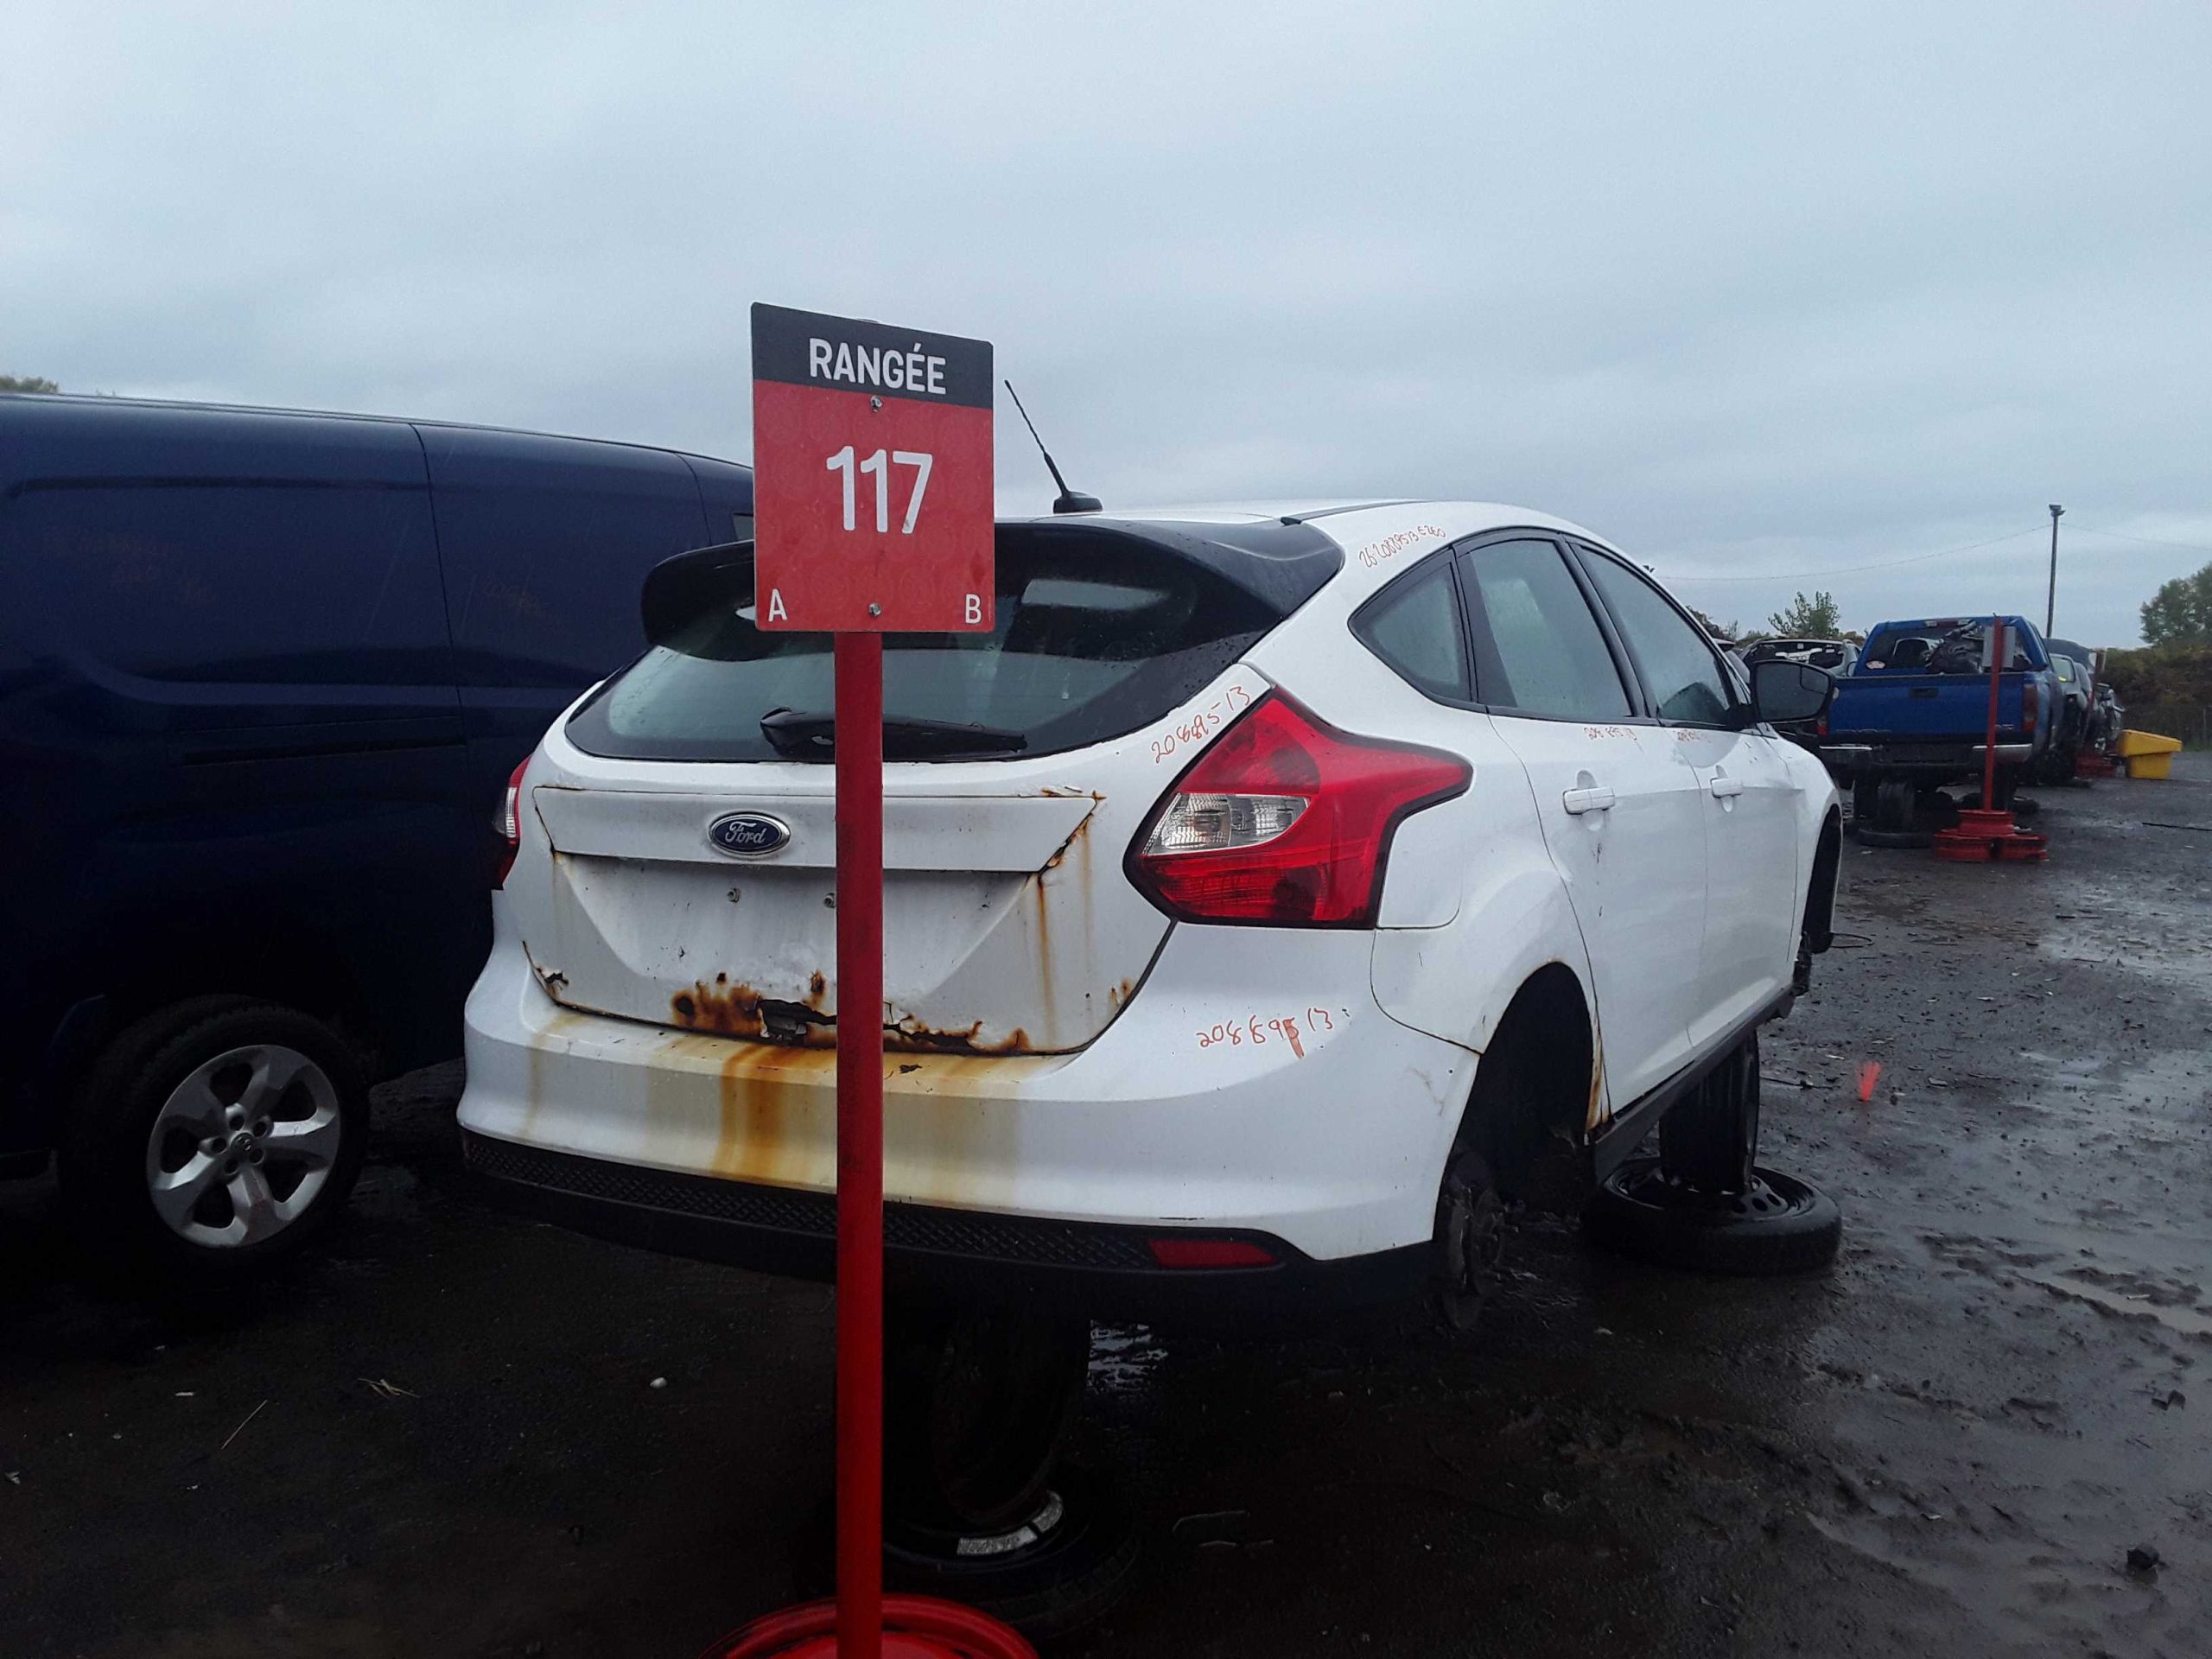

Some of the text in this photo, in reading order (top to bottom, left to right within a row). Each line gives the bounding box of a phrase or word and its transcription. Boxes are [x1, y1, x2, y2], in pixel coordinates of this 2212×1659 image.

[809, 337, 946, 395] RANGÉE
[826, 445, 933, 534] 117
[767, 588, 982, 624] A B
[725, 821, 767, 844] Ford
